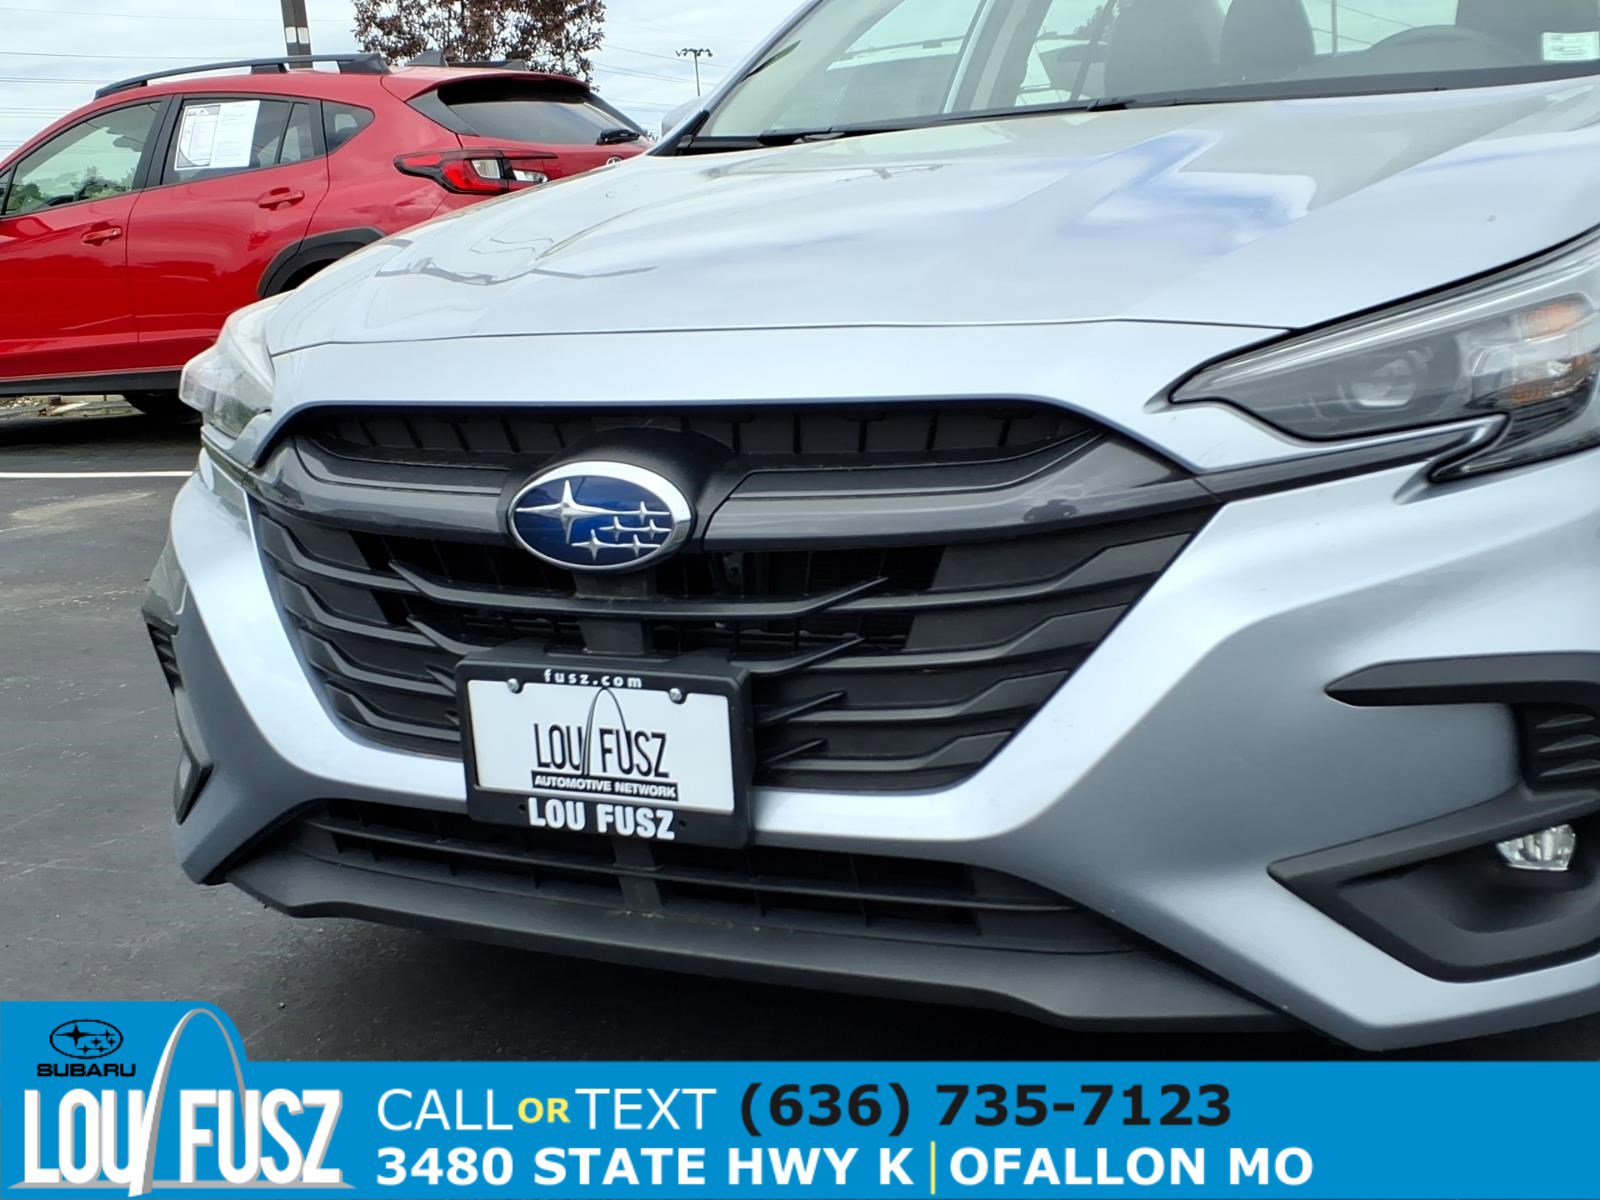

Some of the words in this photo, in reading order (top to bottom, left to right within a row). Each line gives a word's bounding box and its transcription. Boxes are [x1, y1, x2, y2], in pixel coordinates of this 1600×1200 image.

[543, 668, 642, 689] fusz.com
[533, 722, 584, 772] LOU
[599, 727, 670, 778] FUSZ
[534, 774, 612, 793] AUTOMOTIVE
[614, 781, 677, 799] NETWORK
[528, 797, 586, 832] LOU
[596, 803, 676, 841] FUSZ
